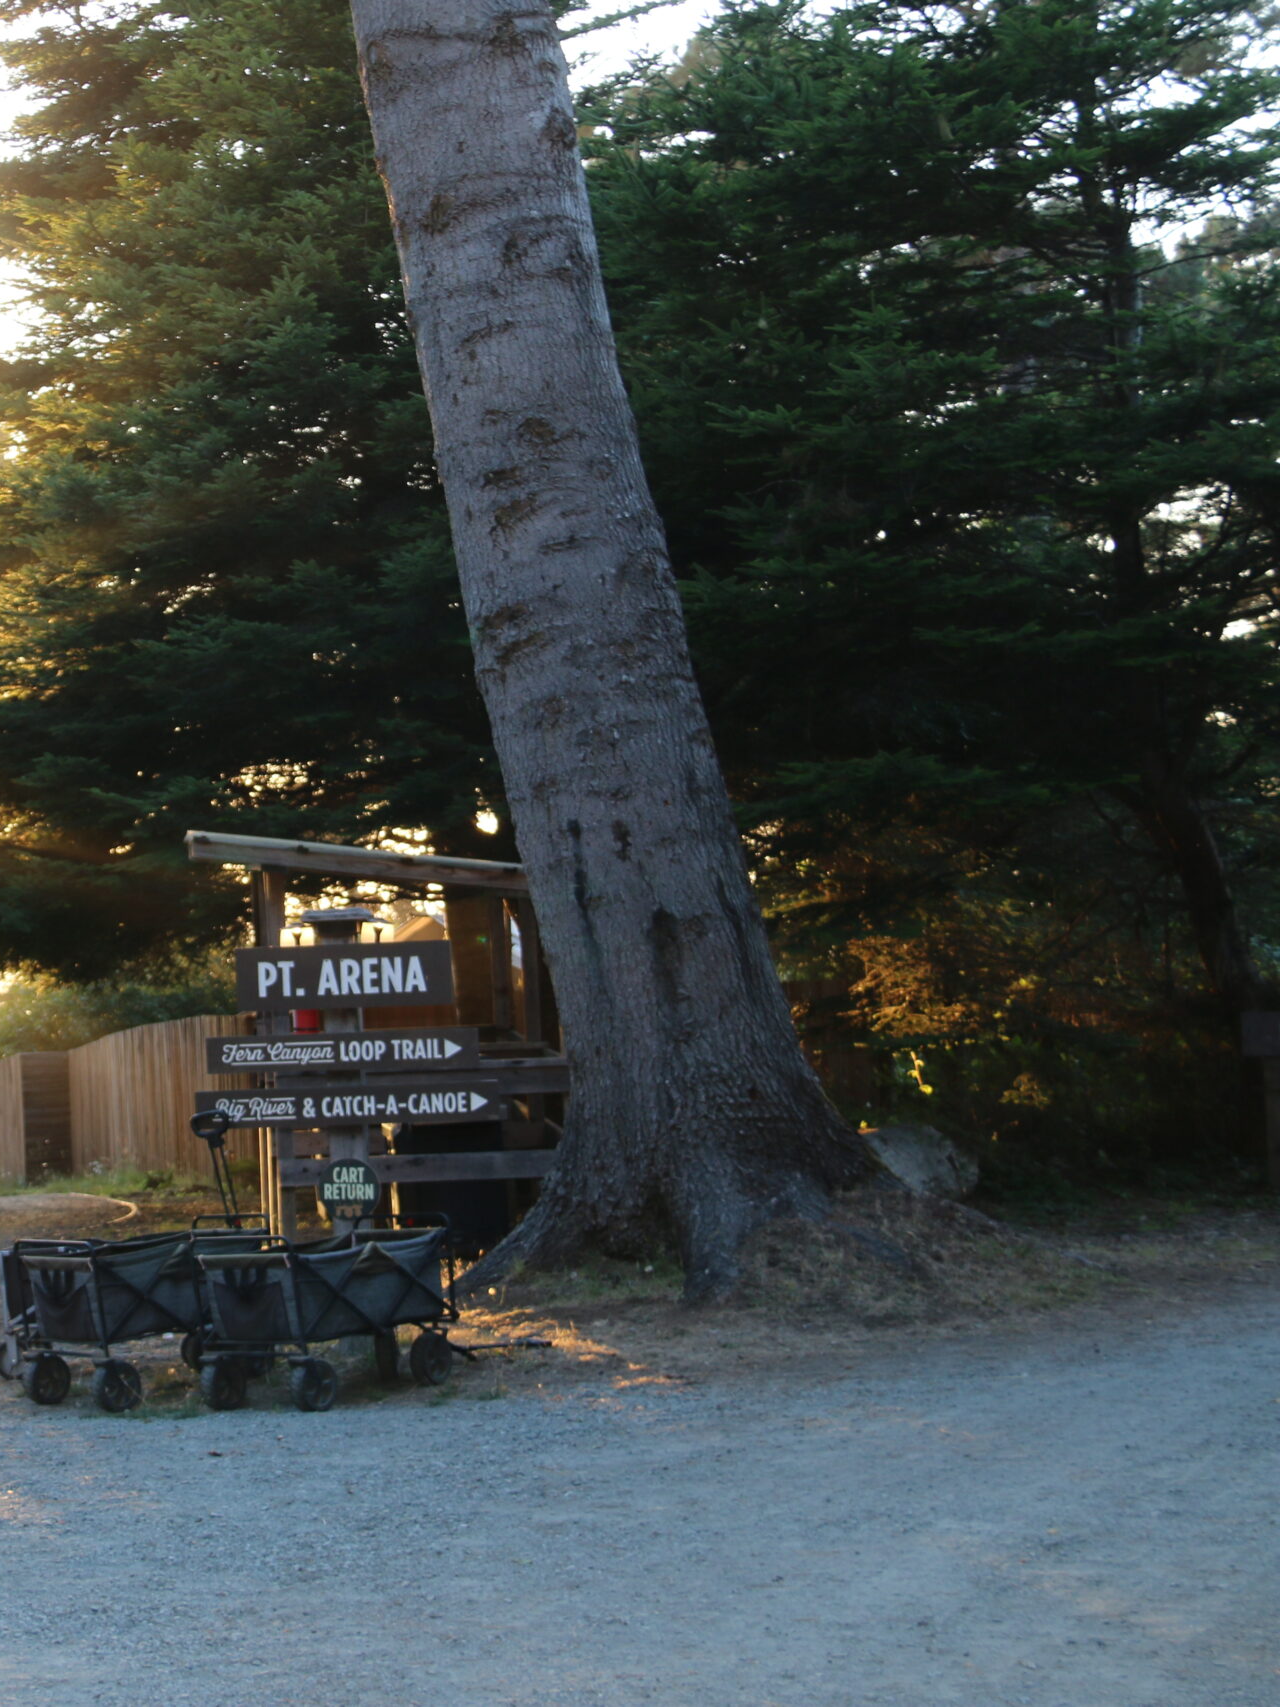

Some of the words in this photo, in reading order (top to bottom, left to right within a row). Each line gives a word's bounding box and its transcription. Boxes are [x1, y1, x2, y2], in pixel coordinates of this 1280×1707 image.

[257, 960, 305, 998] PT.
[317, 955, 427, 996] ARENA
[222, 1043, 264, 1063] Fern
[266, 1042, 334, 1065] Canyon
[339, 1040, 386, 1062] LOOP
[391, 1038, 443, 1060] TRAIL
[215, 1098, 246, 1121] Big
[248, 1097, 296, 1120] River
[302, 1097, 316, 1118] &
[321, 1092, 468, 1118] CATCH-A-CANOE
[332, 1166, 365, 1183] CART
[323, 1183, 375, 1200] RETURN
